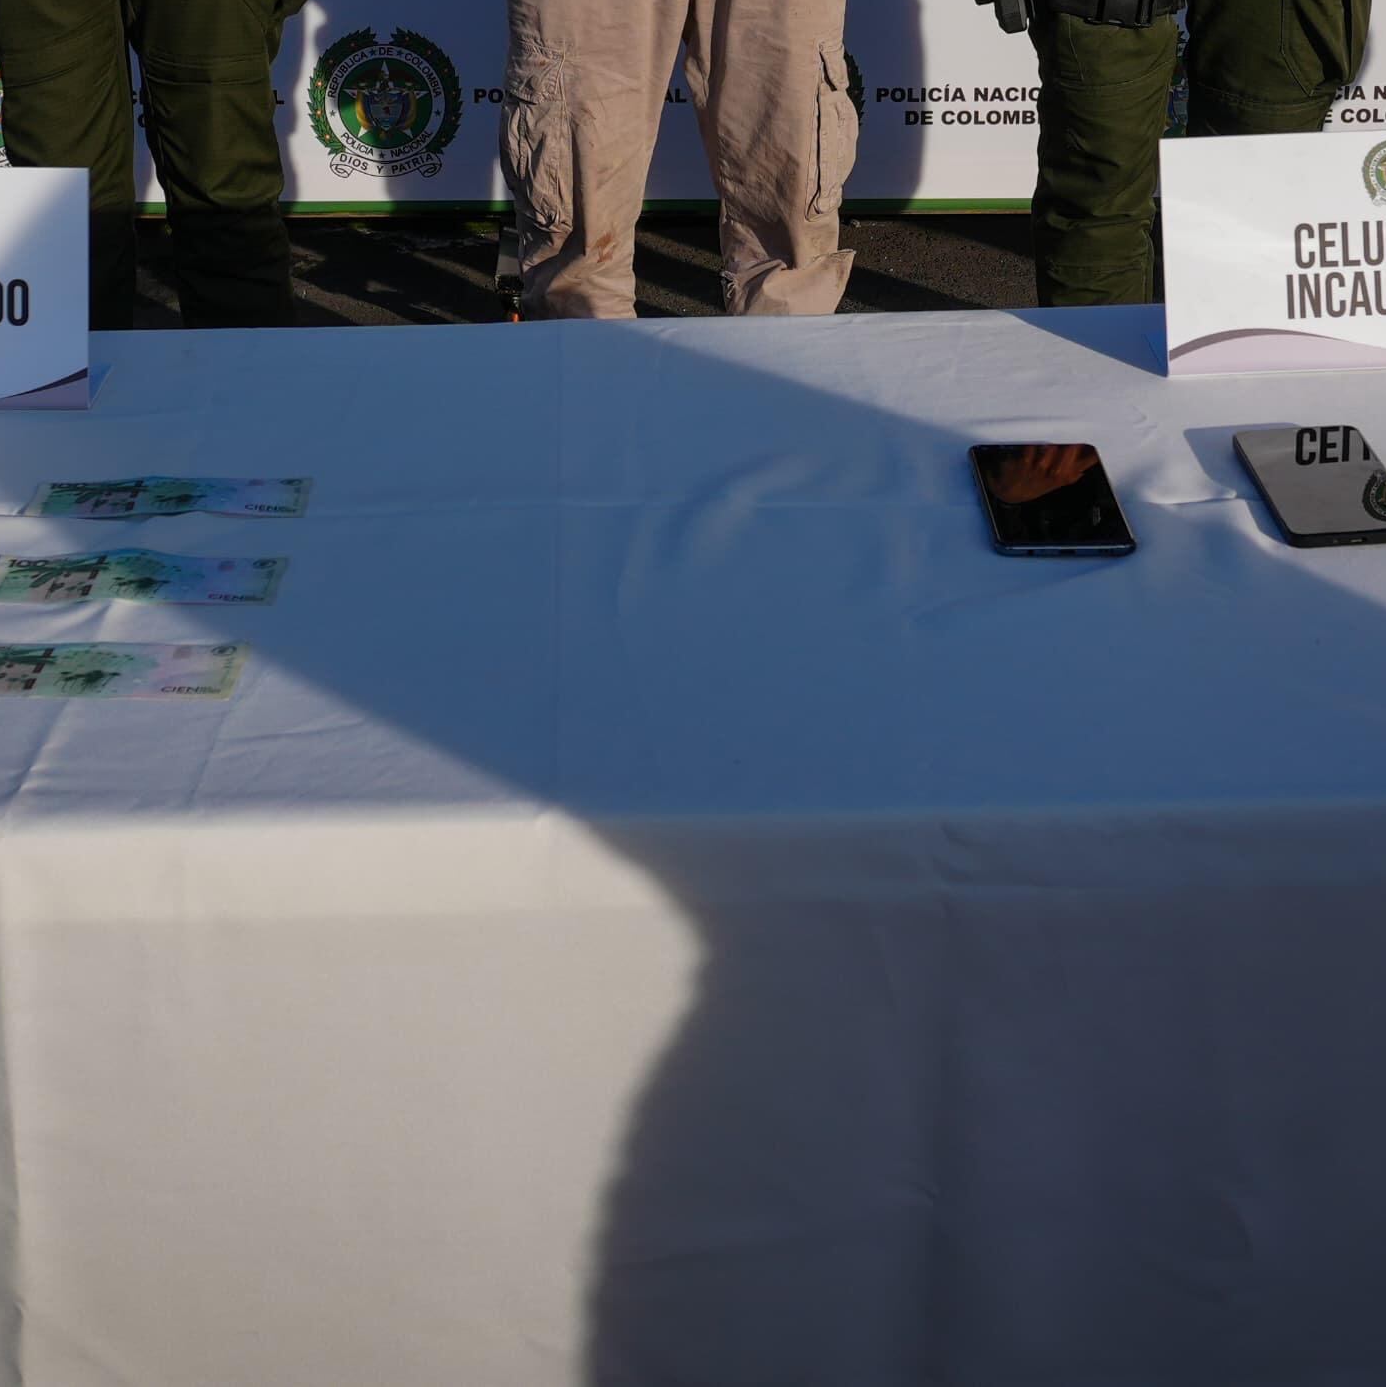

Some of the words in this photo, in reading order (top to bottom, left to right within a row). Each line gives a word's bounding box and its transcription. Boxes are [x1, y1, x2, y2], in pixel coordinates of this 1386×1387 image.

[876, 84, 966, 103] POLICÍA
[973, 86, 1041, 102] NACIO
[904, 110, 934, 126] DE
[941, 110, 1041, 126] COLOMB
